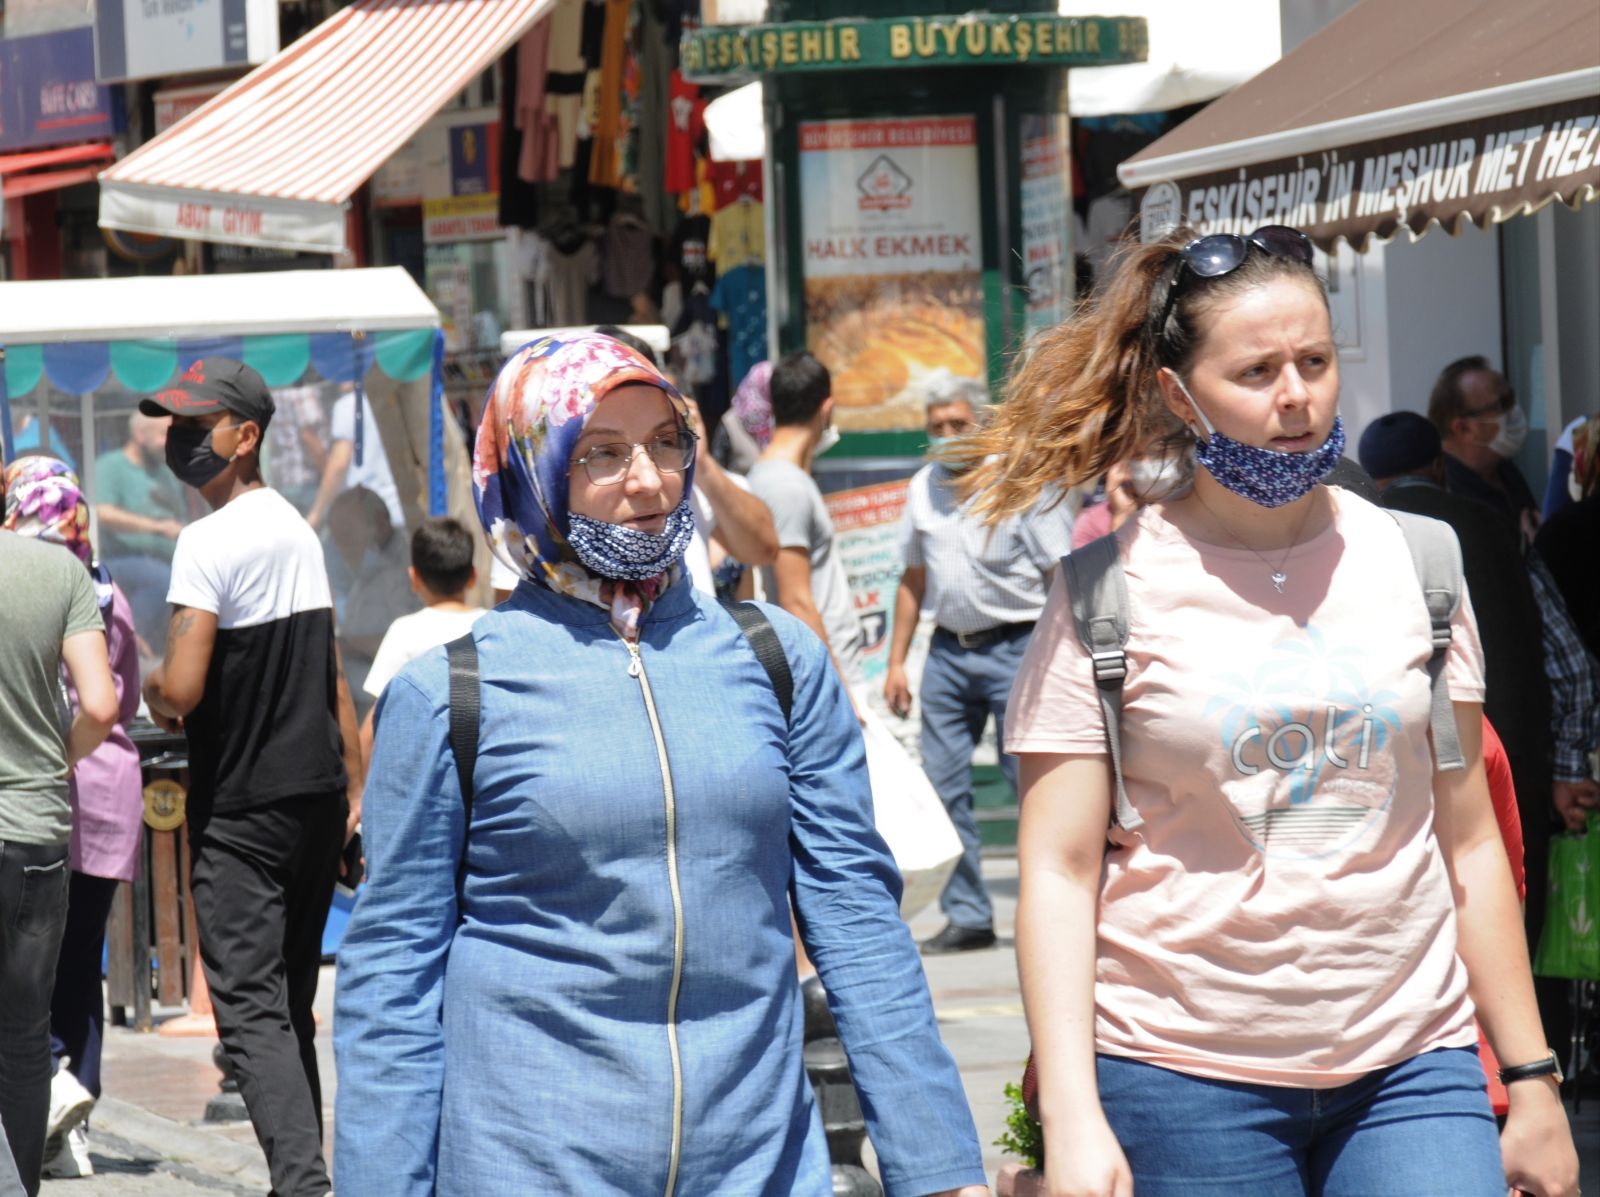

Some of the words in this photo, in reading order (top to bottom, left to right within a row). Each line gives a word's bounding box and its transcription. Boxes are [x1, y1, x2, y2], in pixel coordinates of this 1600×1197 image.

[1355, 137, 1477, 224] MEŞHUR
[1474, 124, 1545, 195] MET
[1535, 114, 1600, 182] HEL
[807, 238, 867, 258] HALK
[875, 235, 970, 257] EKMEK
[1232, 703, 1374, 776] cali
